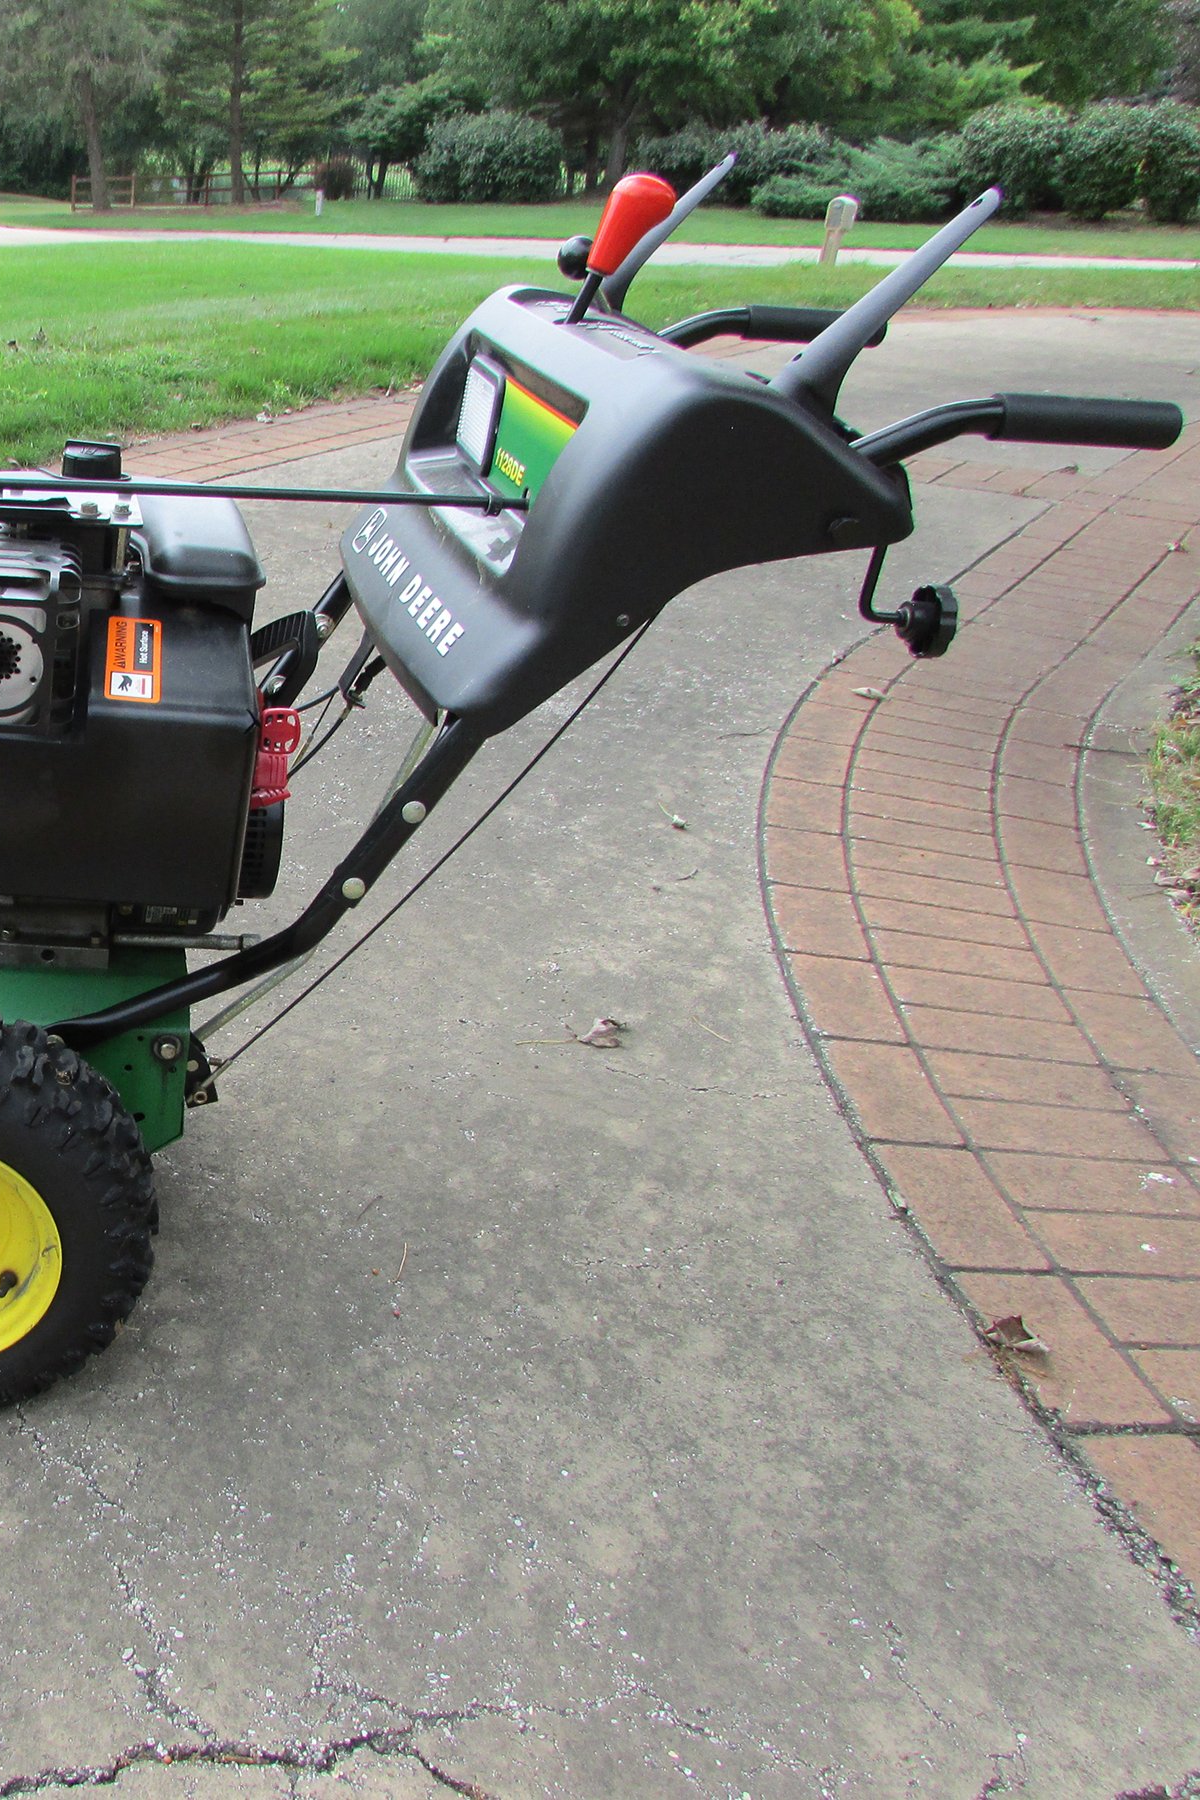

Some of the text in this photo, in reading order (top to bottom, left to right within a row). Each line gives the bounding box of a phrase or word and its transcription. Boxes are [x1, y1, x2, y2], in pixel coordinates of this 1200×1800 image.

[495, 447, 525, 487] 1128DE
[368, 533, 465, 657] JOHN DEERE
[114, 621, 128, 660] WARNING
[139, 630, 149, 664] Hot Surface
